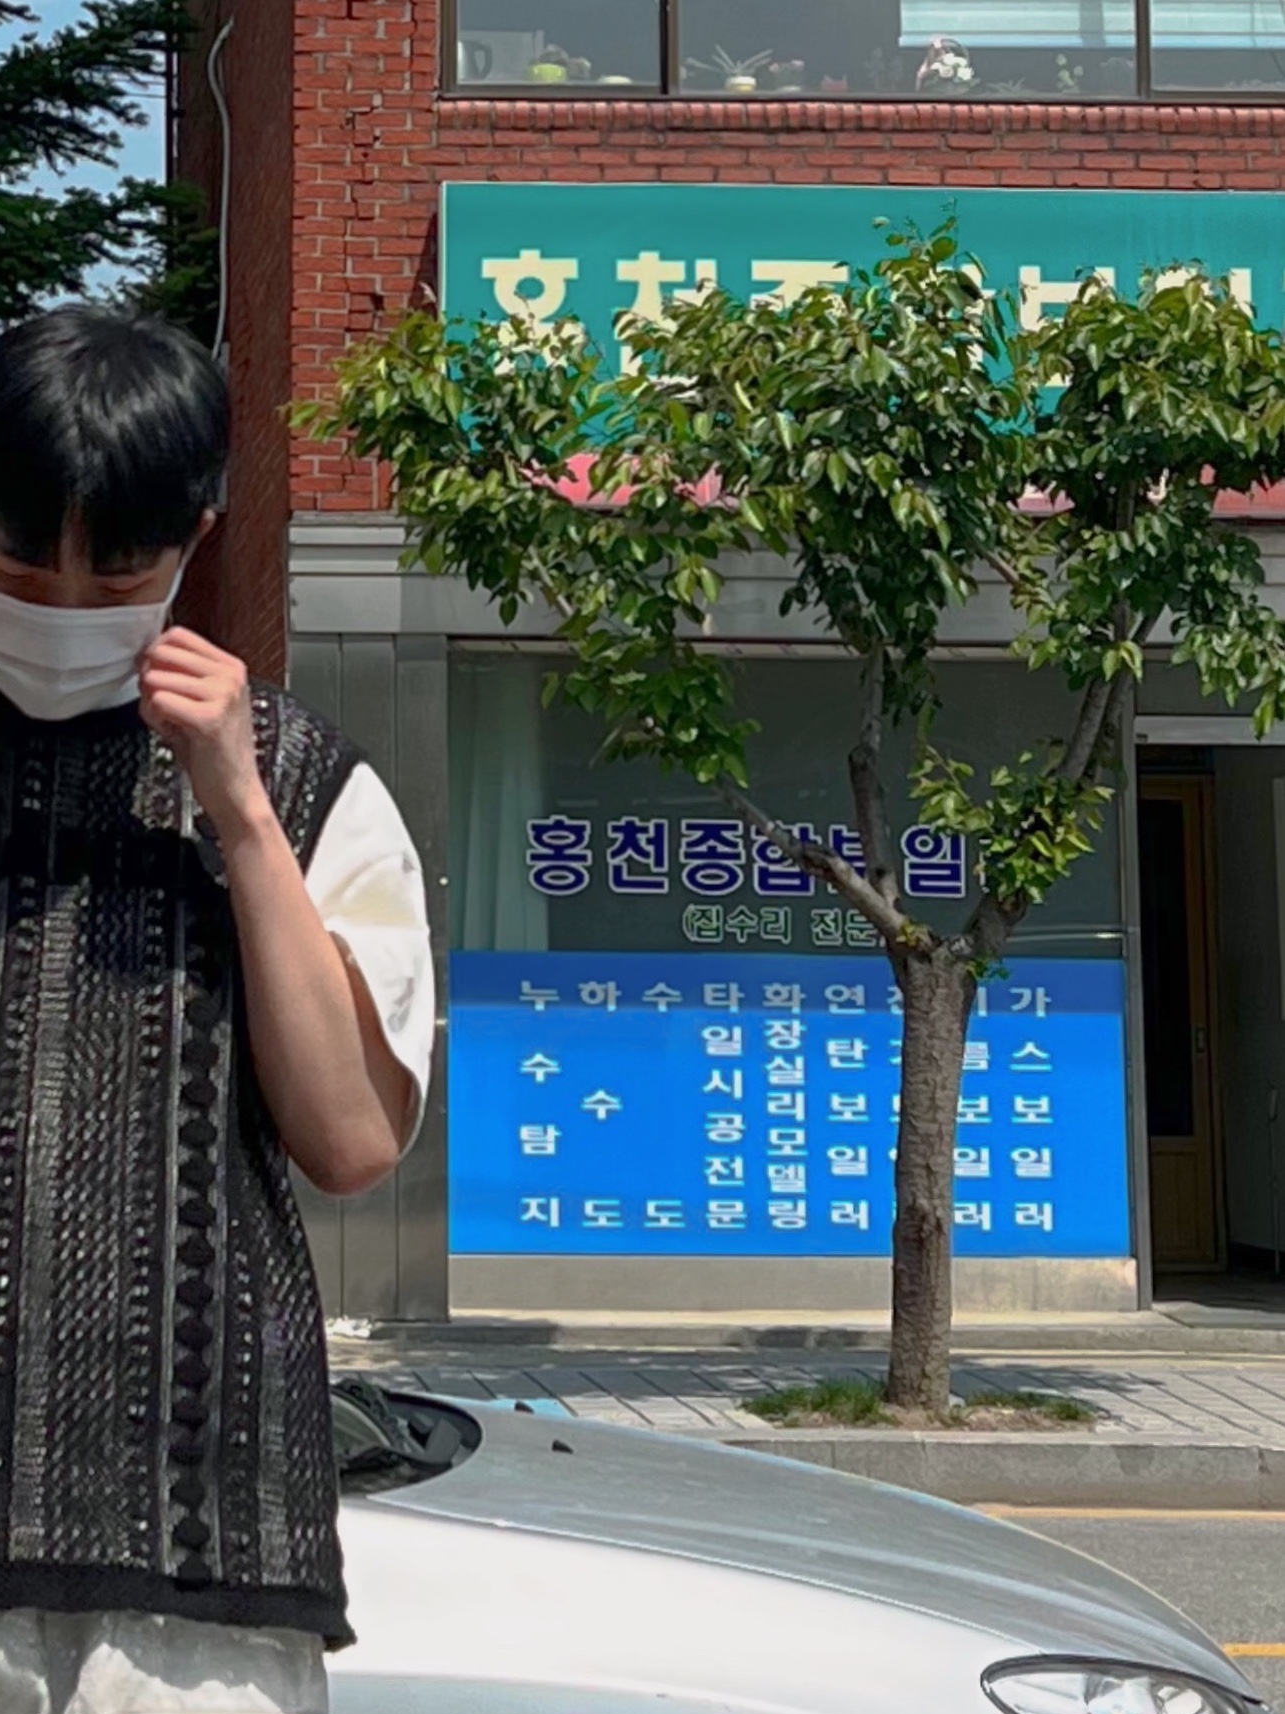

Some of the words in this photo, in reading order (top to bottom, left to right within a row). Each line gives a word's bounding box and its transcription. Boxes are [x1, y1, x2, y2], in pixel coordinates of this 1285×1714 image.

[682, 903, 792, 944] (집수리
[519, 980, 562, 1228] 누수탐지
[578, 980, 624, 1228] 하수도
[700, 982, 747, 1229] 타일시공전문
[762, 982, 809, 1230] 화장실리모델링
[824, 984, 870, 1231] 연탄보일러
[1009, 986, 1054, 1233] 가스보일러
